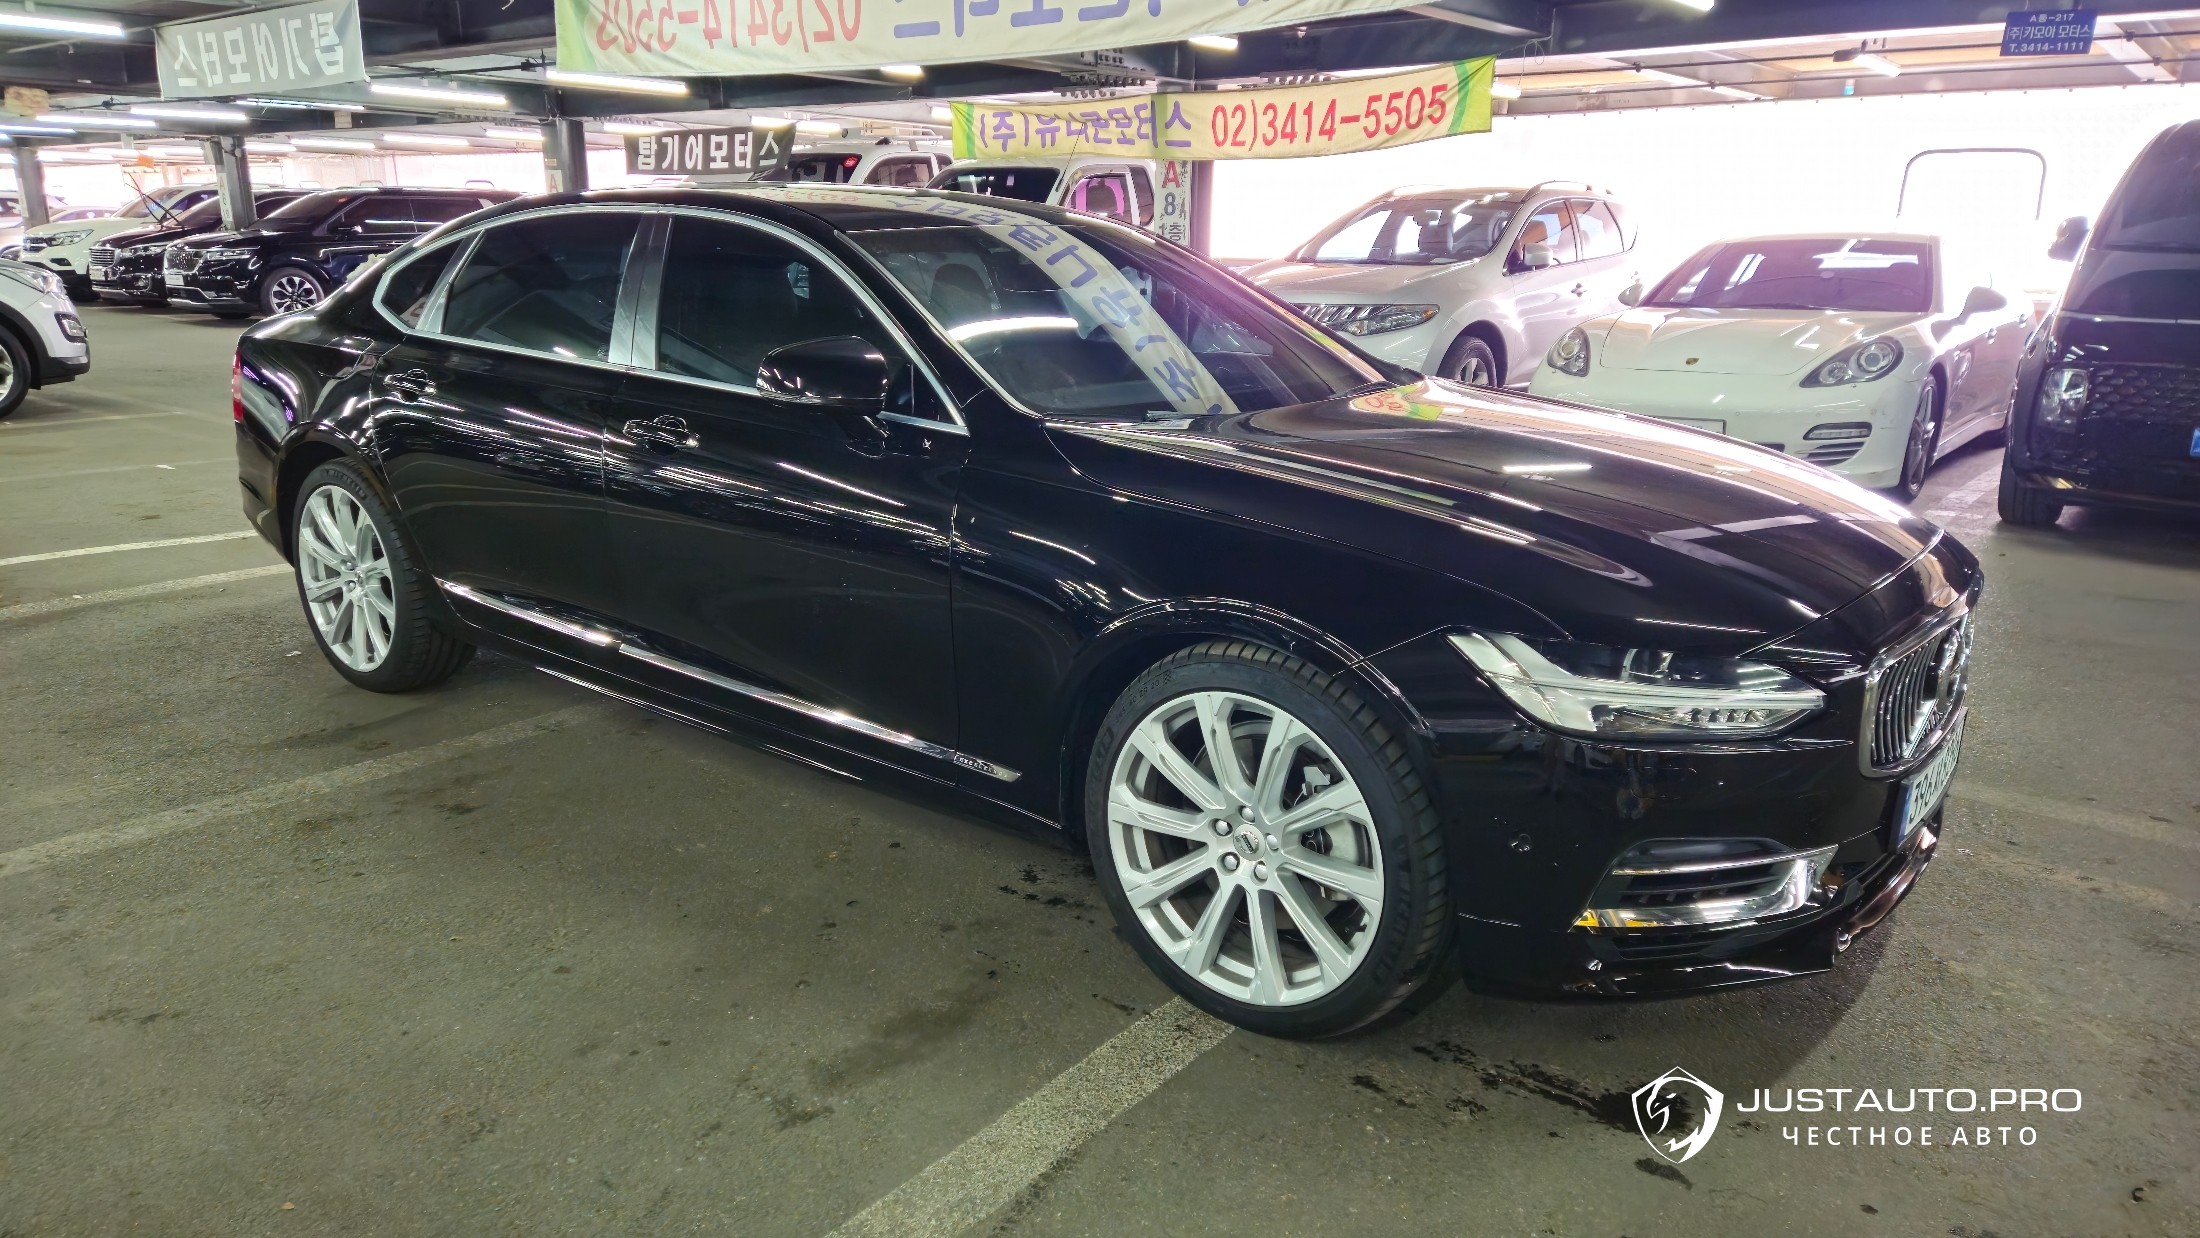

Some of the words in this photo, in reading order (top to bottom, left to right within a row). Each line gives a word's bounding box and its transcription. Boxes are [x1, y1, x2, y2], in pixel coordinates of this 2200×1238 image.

[2058, 24, 2090, 37] 모터스
[1211, 83, 1449, 152] 02)3414-5505
[637, 130, 780, 171] 탑기어모터스
